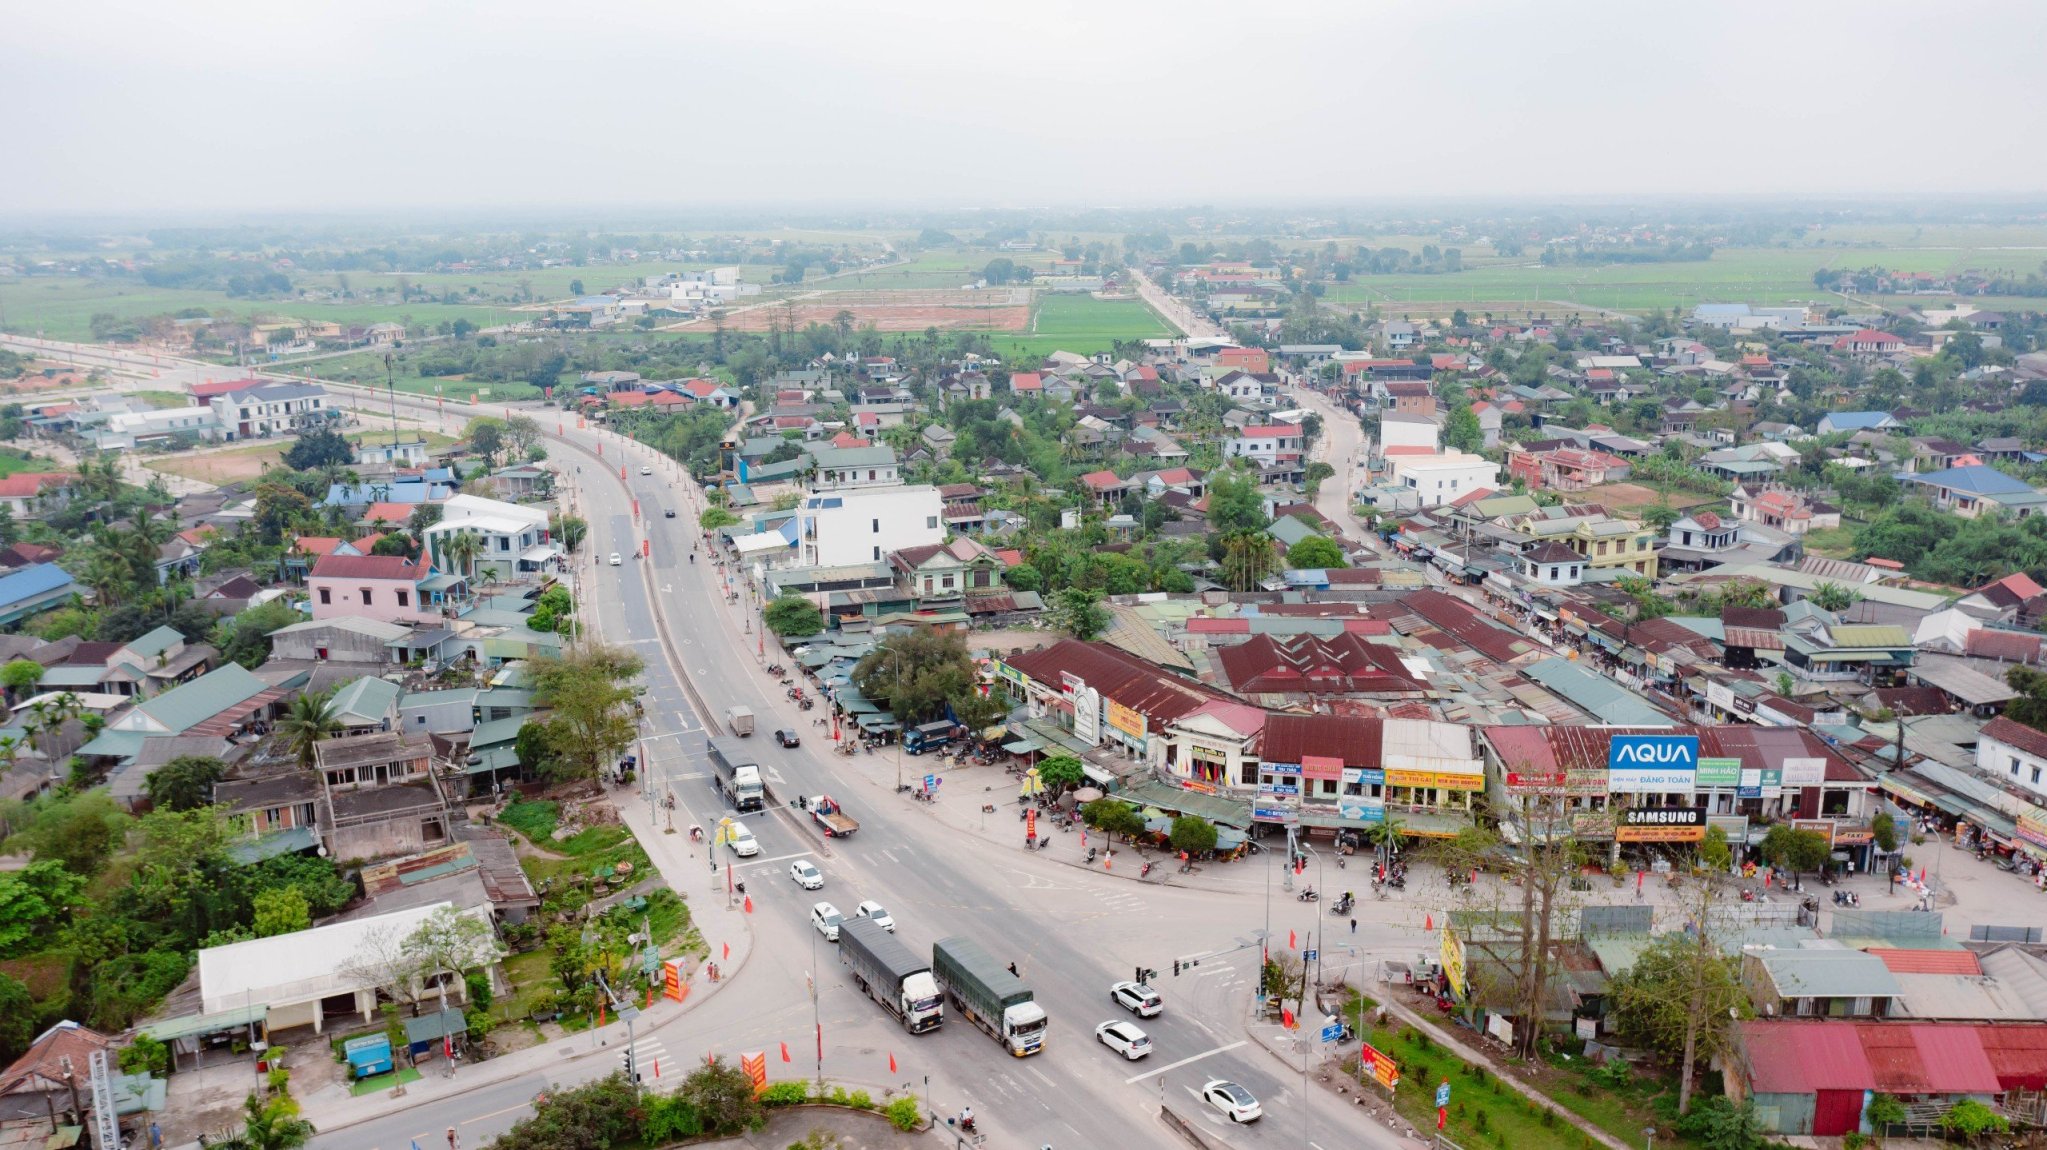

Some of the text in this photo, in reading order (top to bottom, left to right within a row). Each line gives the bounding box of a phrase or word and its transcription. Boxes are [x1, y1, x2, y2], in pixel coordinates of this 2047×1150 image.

[1616, 743, 1691, 763] AQUA
[1699, 767, 1719, 775] MINH
[1627, 811, 1697, 823] SAMSUNG
